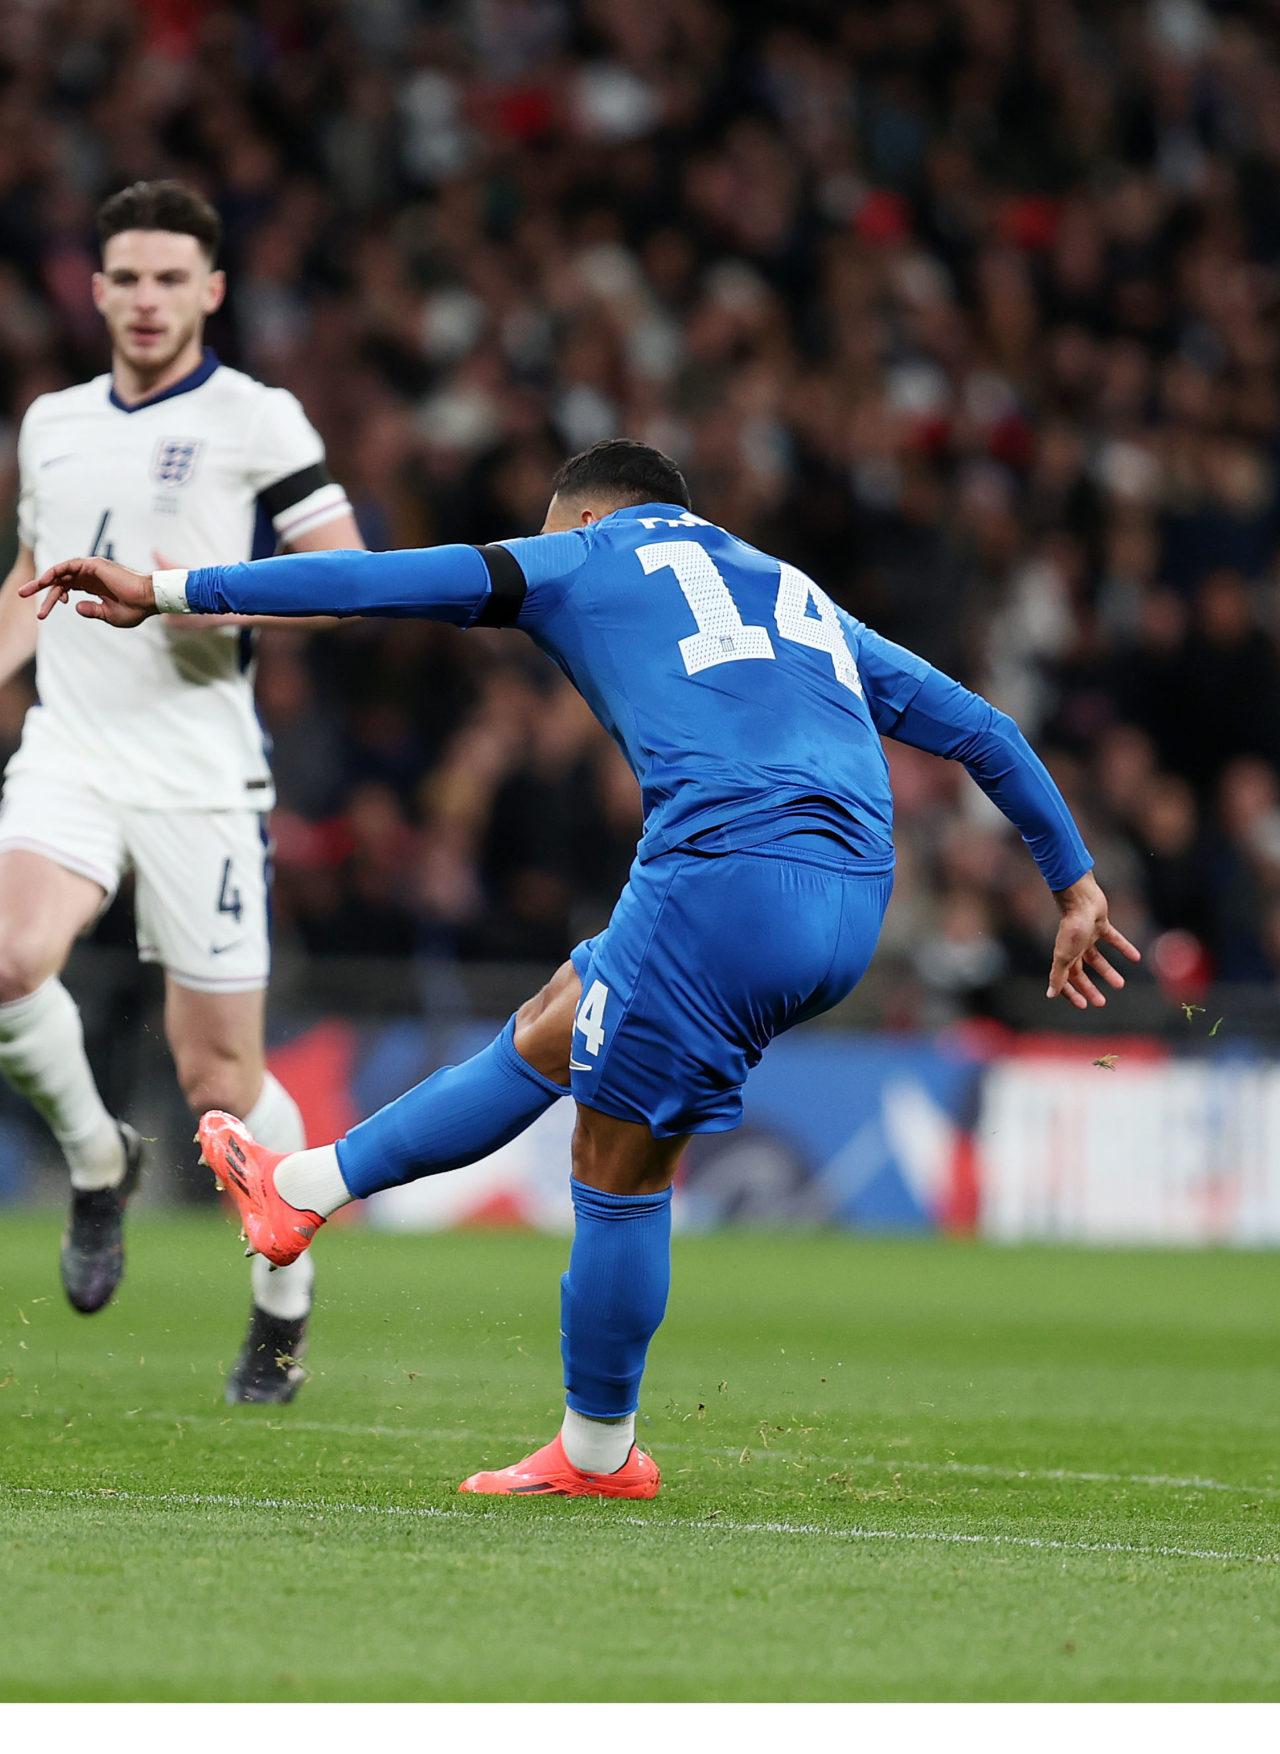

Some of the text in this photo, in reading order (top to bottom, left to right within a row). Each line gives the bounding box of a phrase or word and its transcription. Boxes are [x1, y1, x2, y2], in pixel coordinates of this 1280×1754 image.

[634, 540, 864, 701] 14
[218, 857, 242, 924] 4
[572, 979, 609, 1057] 4
